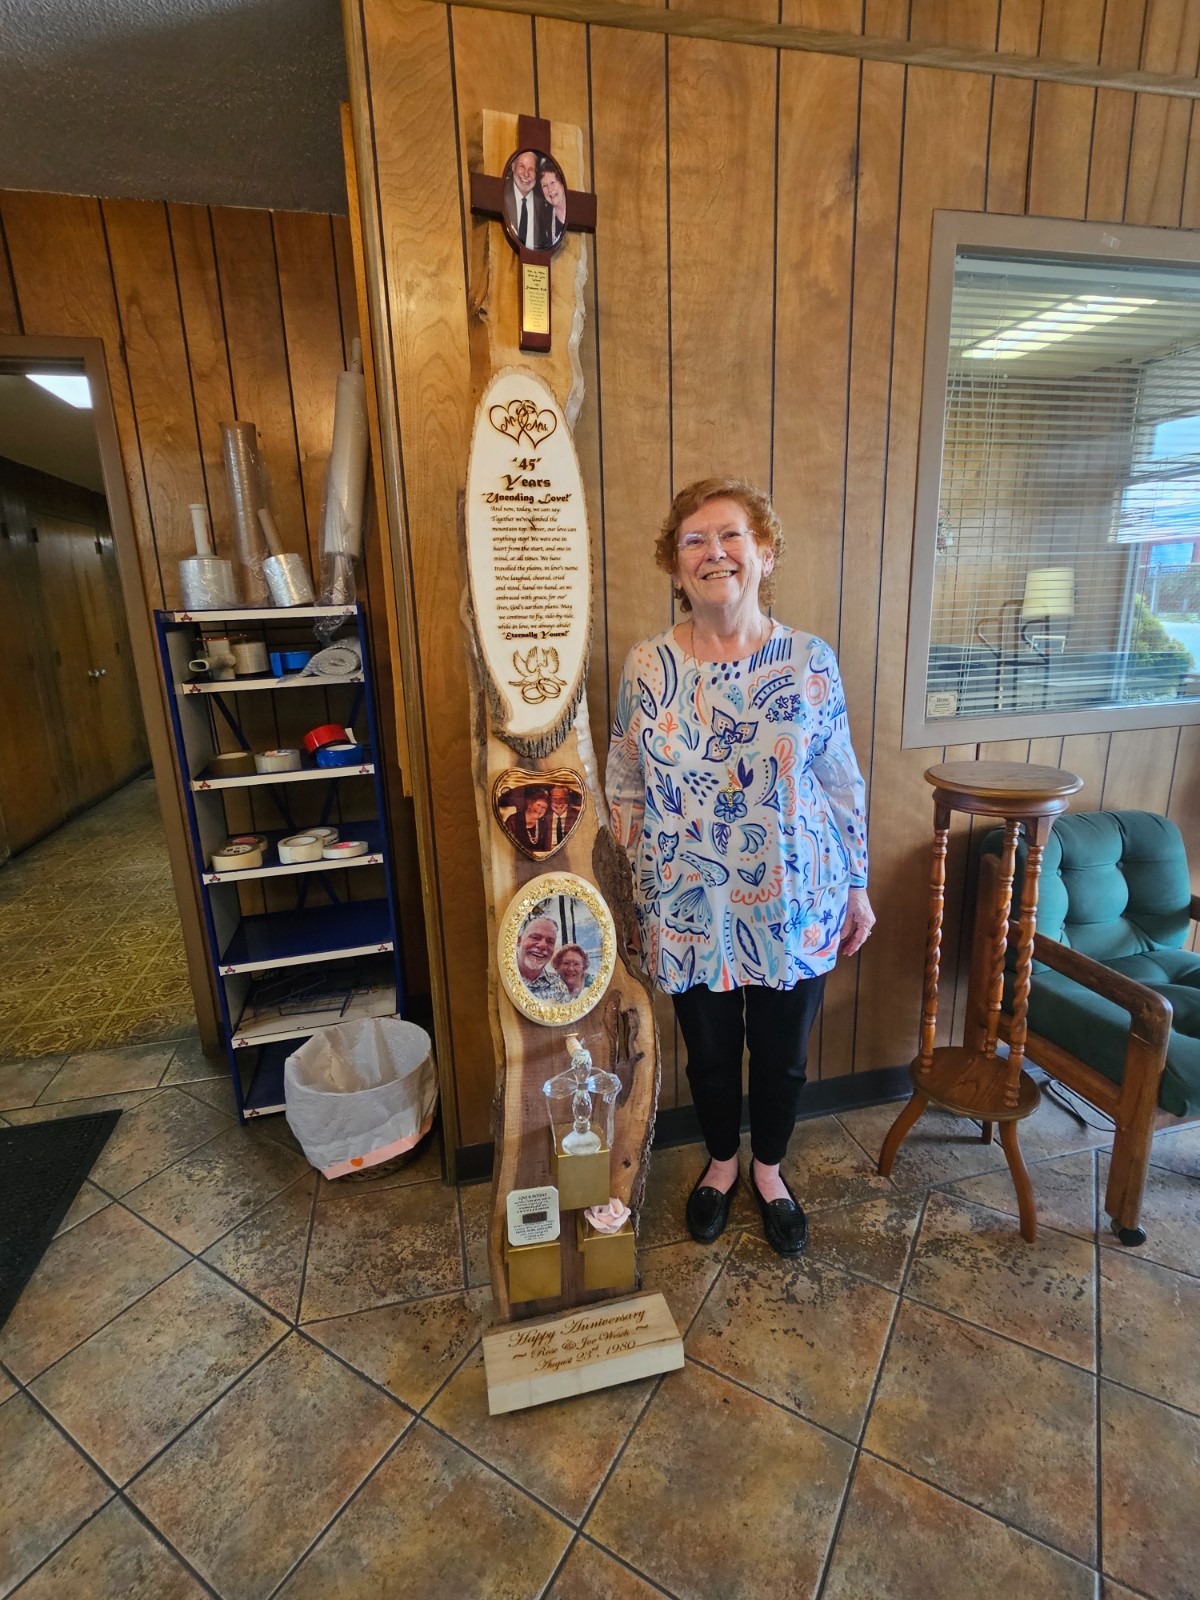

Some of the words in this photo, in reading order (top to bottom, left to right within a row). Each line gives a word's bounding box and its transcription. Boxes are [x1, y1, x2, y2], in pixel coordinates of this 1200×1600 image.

[526, 419, 549, 432] Mrs.
[501, 474, 551, 491] Years
[516, 505, 532, 514] today,
[491, 515, 514, 524] Together
[493, 535, 517, 544] anything
[507, 545, 521, 553] from
[526, 565, 543, 573] plains,
[510, 574, 532, 583] laughed,
[547, 594, 556, 602] for
[538, 623, 555, 631] always
[508, 1328, 556, 1348] Happy
[560, 1310, 646, 1335] Anniversary
[531, 1345, 559, 1359] Rose
[561, 1339, 577, 1350] &
[576, 1337, 597, 1350] Joe
[534, 1357, 573, 1373] August
[606, 1340, 636, 1355] 1980
